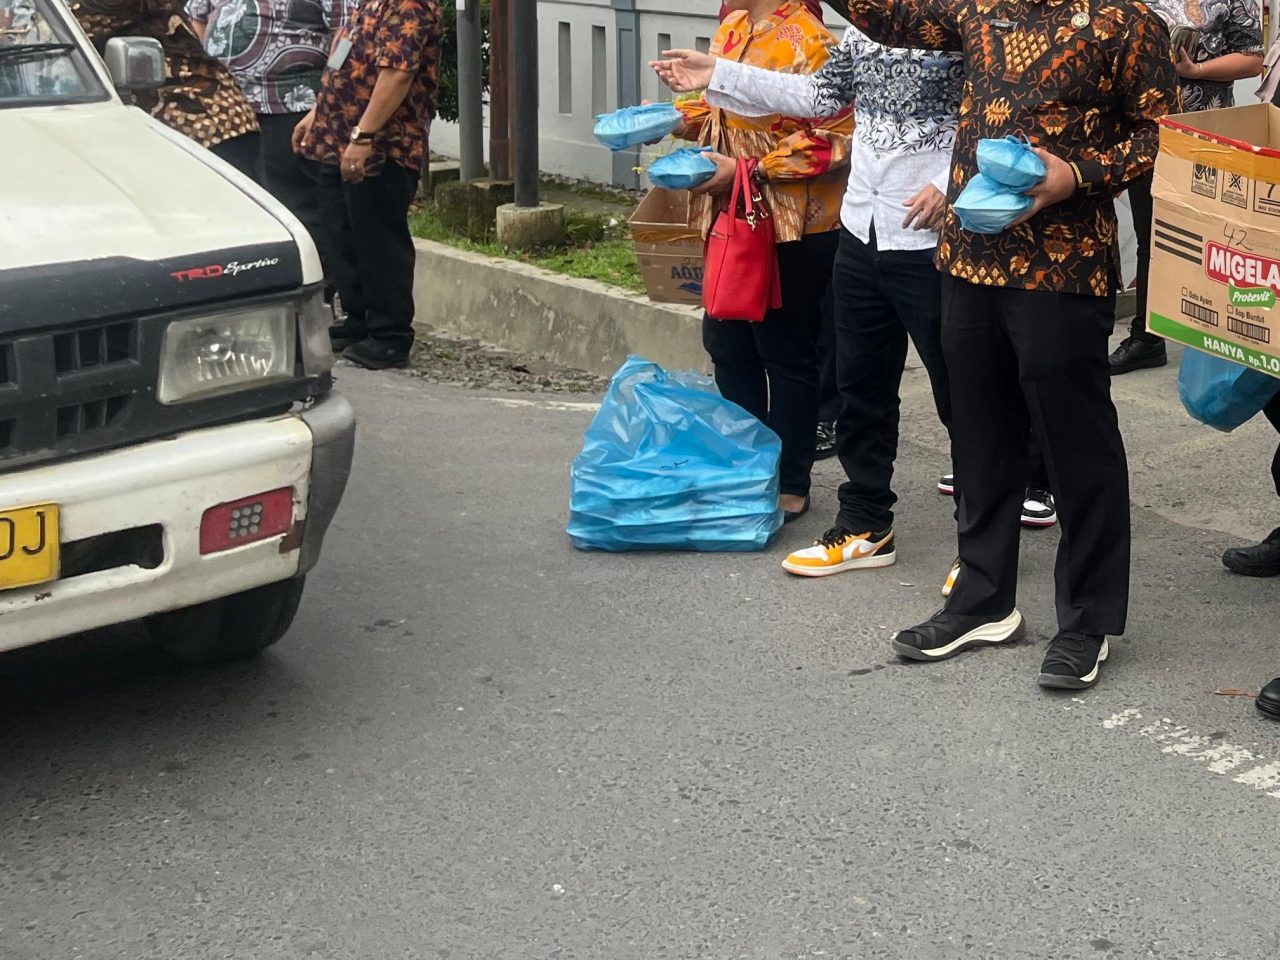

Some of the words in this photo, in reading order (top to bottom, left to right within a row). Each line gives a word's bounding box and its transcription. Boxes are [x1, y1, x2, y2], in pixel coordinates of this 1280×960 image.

[1223, 223, 1253, 251] 42
[170, 264, 224, 282] TRD
[1188, 291, 1199, 300] Soto
[1199, 295, 1213, 307] Ayam
[1231, 290, 1271, 303] Protevit
[1235, 307, 1246, 319] Sop
[1246, 311, 1265, 324] Buntut
[1203, 336, 1246, 361] HANYA
